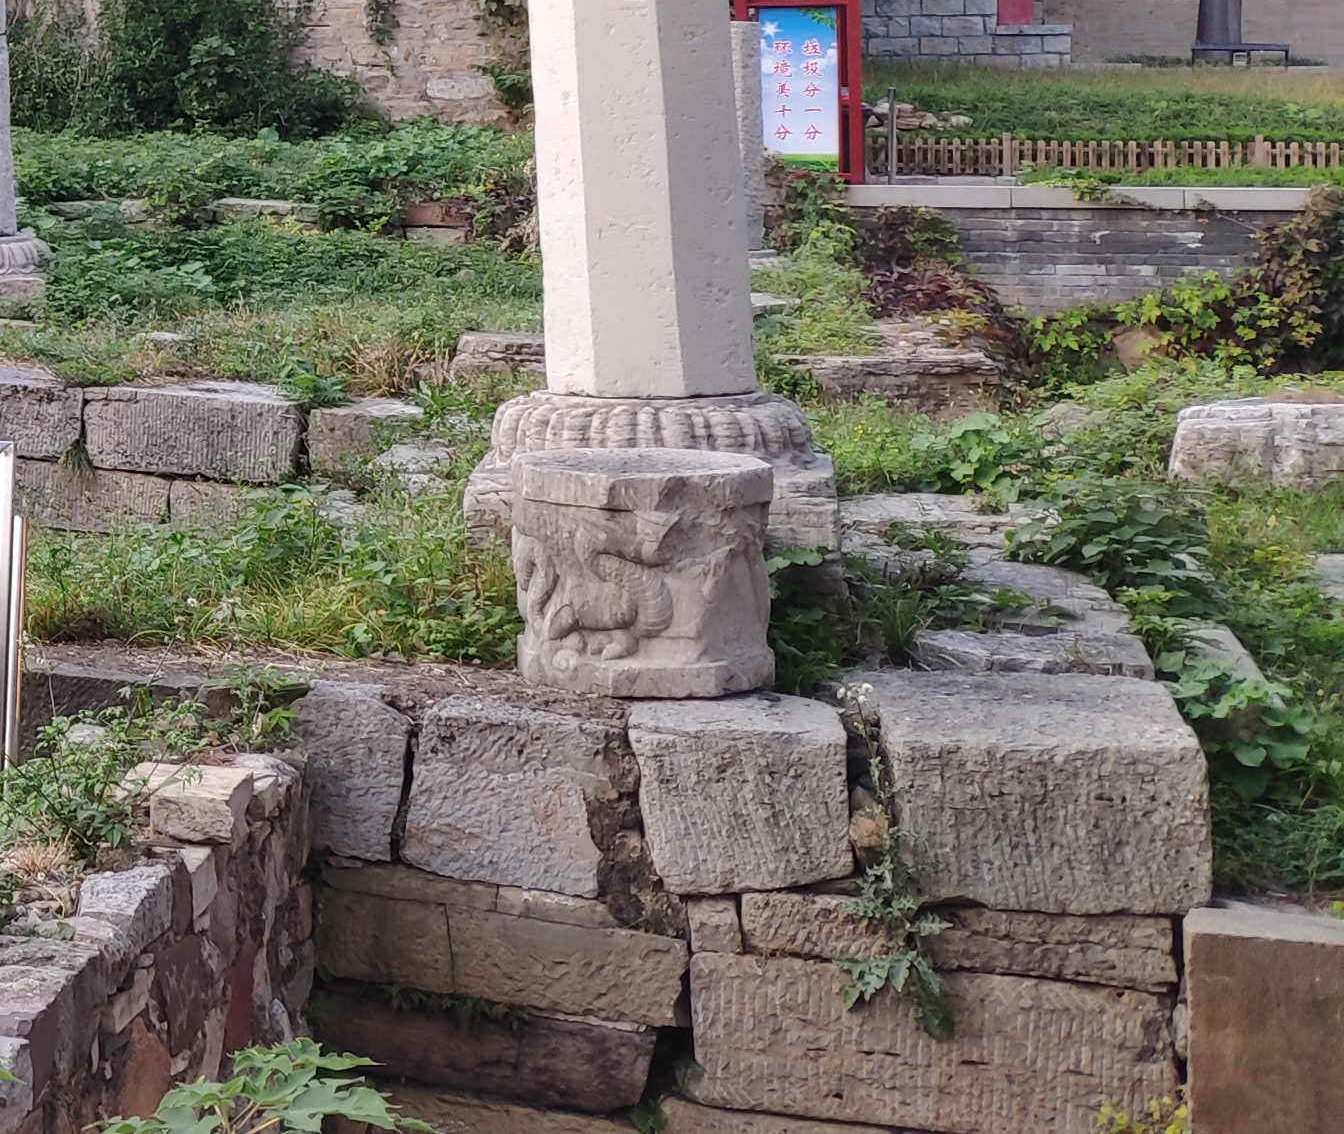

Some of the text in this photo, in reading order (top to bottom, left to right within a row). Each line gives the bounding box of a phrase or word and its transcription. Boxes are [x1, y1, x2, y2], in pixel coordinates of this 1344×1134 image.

[773, 41, 793, 141] 环境美十分
[803, 39, 823, 141] 垃圾分一分
